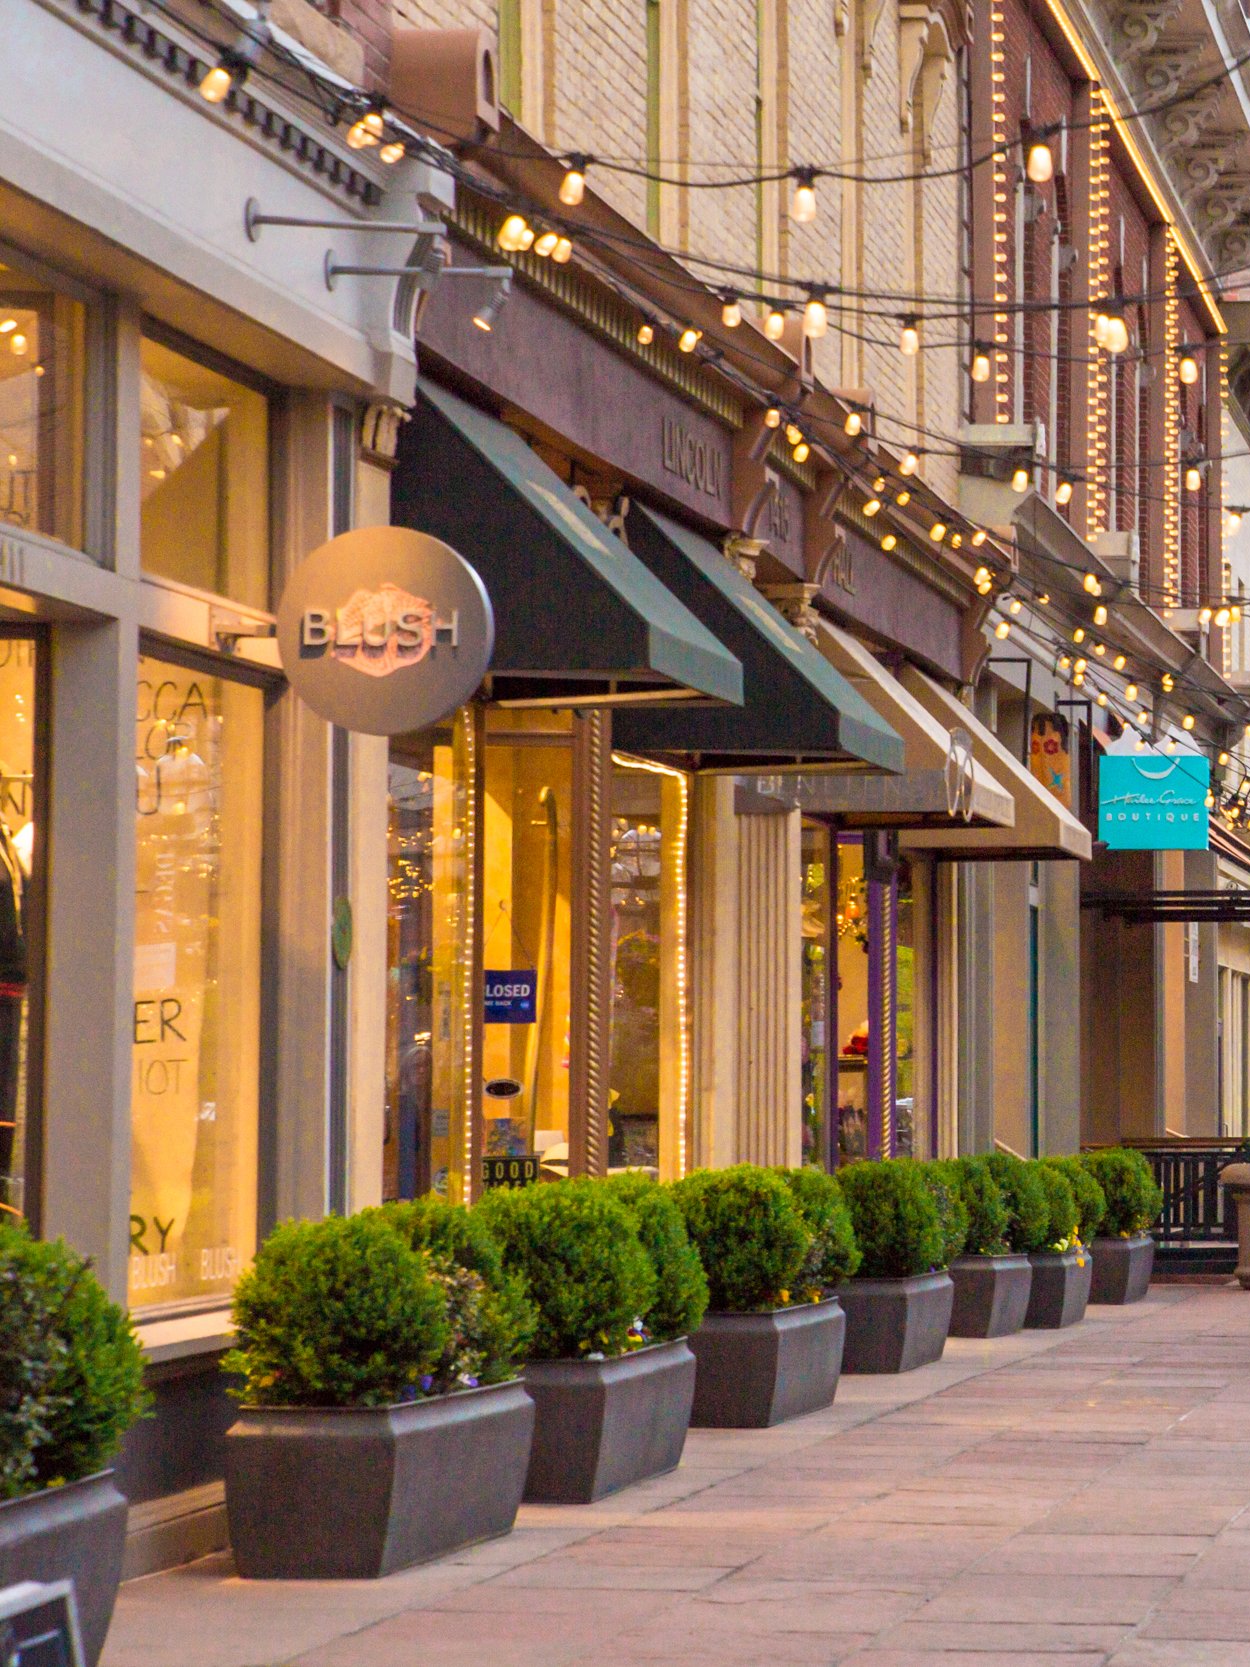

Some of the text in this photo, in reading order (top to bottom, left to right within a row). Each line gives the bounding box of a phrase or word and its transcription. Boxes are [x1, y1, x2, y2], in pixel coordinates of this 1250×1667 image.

[661, 416, 722, 500] LINCOLN
[303, 609, 459, 651] BLUSH
[1105, 812, 1200, 823] BOUTIQUE
[485, 983, 531, 998] LOSED
